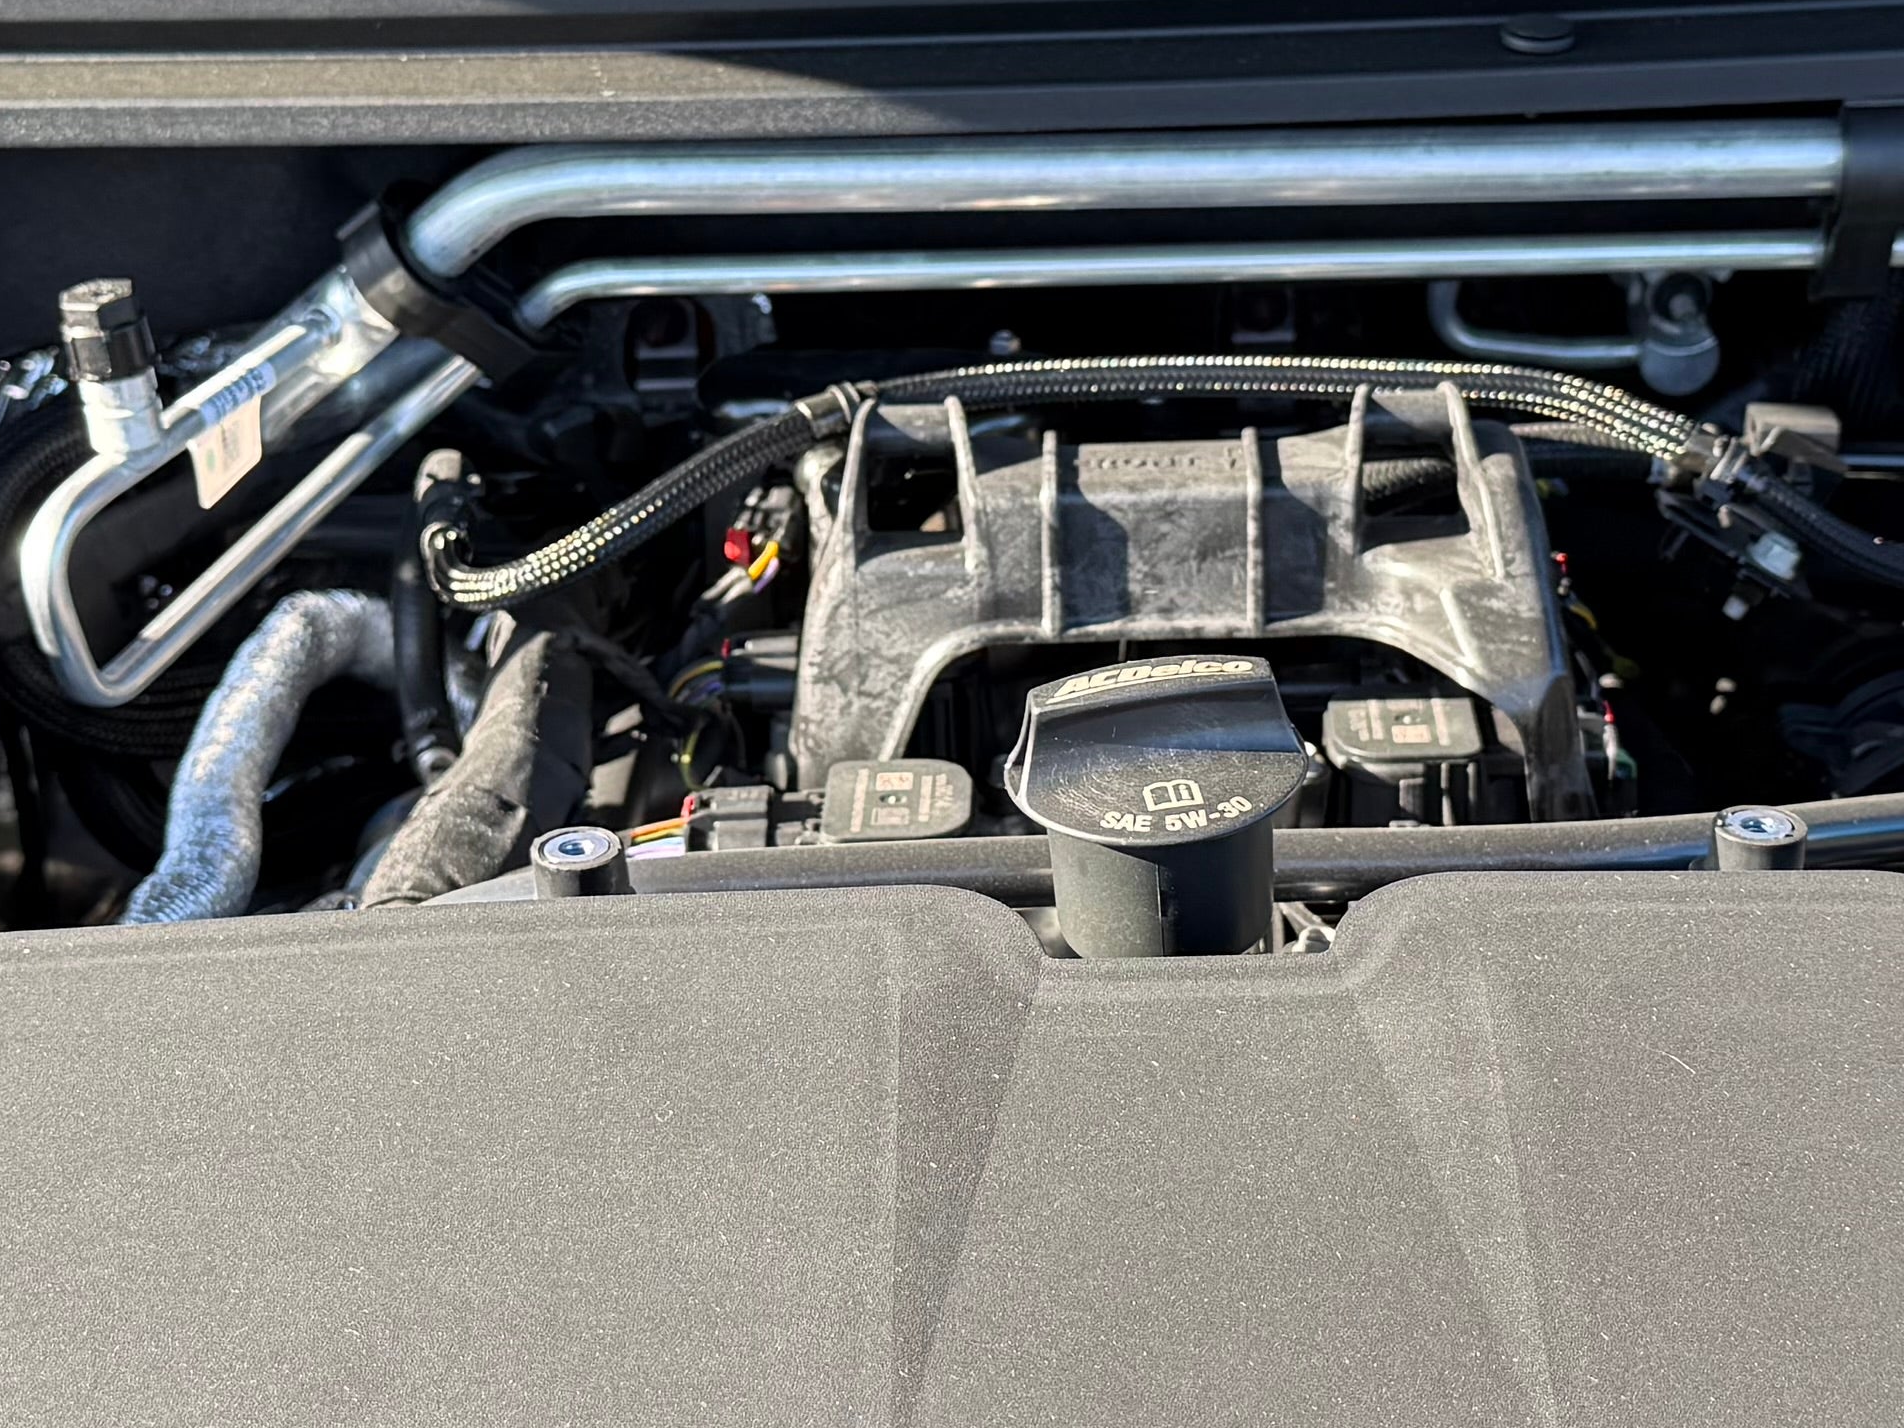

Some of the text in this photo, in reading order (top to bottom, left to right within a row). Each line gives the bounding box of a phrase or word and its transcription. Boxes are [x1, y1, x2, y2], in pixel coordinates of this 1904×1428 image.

[1048, 659, 1253, 701] ACDelco
[1100, 795, 1253, 832] SAE 5W-30
